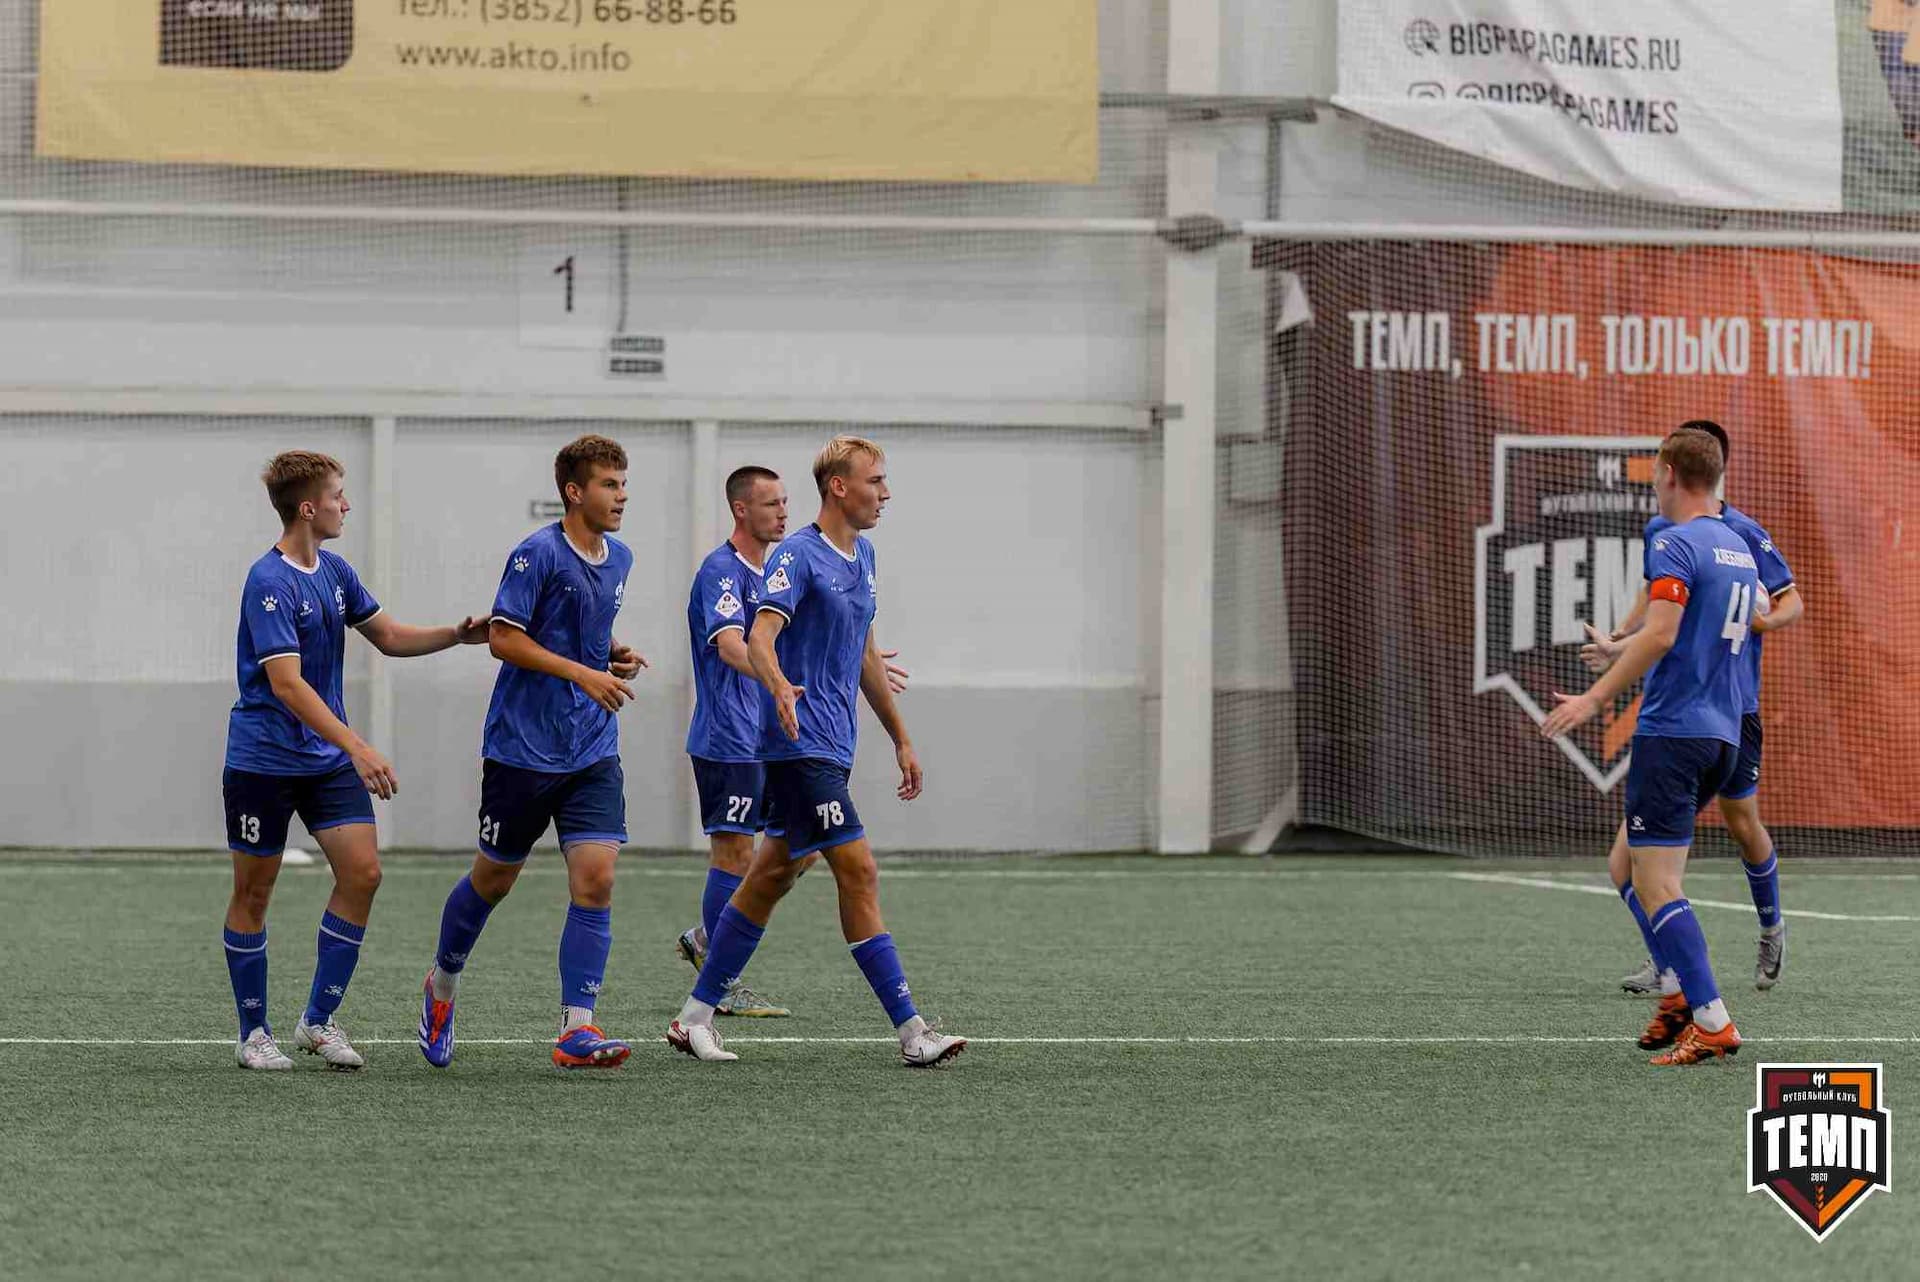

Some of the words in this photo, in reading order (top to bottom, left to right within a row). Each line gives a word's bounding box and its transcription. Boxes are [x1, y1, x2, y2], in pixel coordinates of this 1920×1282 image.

[593, 0, 737, 25] 66-88-66
[396, 42, 632, 72] www.akto.info
[1450, 22, 1682, 71] BIGPAPAGAMES.RU
[553, 256, 574, 313] 1
[1350, 311, 1462, 379] ТЕМП,
[1475, 313, 1588, 379] ТЕМП,
[1602, 315, 1750, 375] ТОЛЬКО
[1764, 317, 1873, 378] ТЕМП!
[1503, 536, 1646, 652] ТЕМ
[1721, 582, 1750, 655] 4
[727, 796, 753, 823] 27
[816, 800, 845, 831] 78
[240, 814, 260, 843] 13
[481, 815, 500, 846] 21
